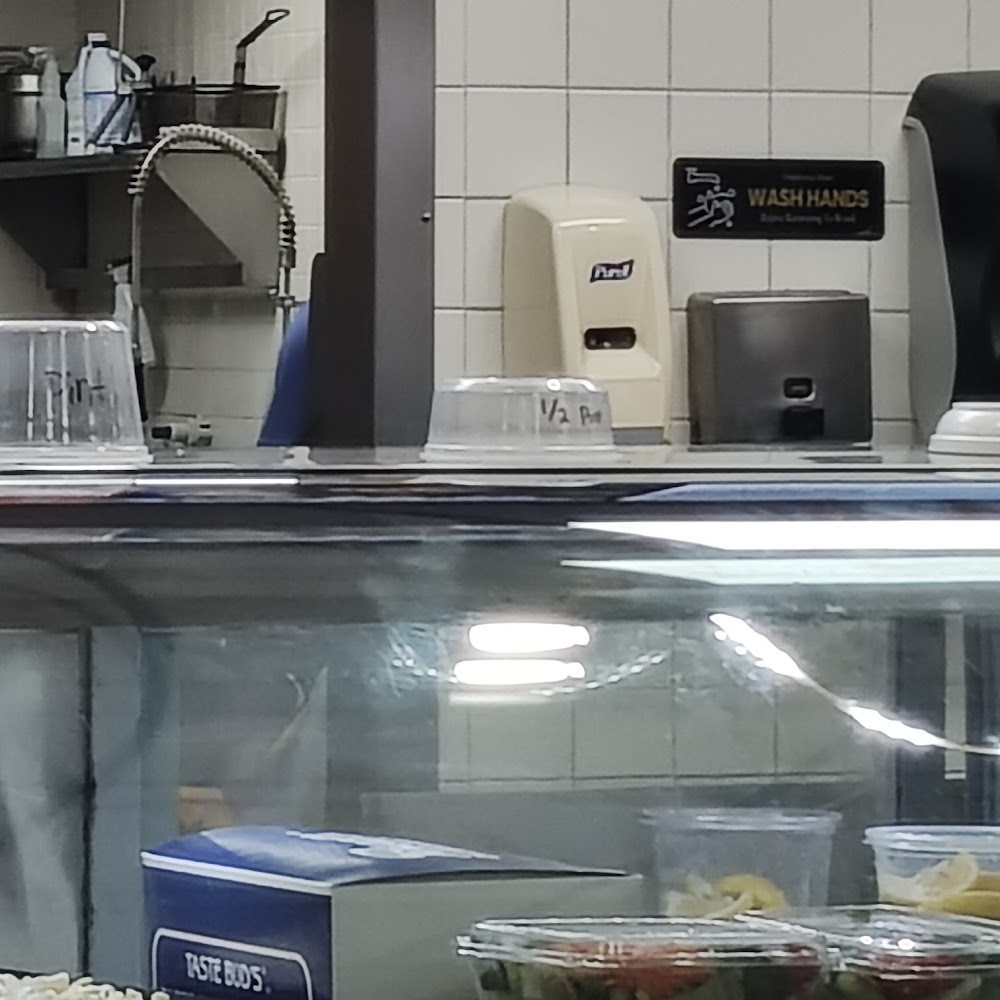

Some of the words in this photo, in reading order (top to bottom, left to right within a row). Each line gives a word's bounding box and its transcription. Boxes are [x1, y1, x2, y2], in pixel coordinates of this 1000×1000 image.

[748, 188, 803, 208] WASH
[807, 189, 870, 209] HANDS
[184, 952, 223, 985] TASTE
